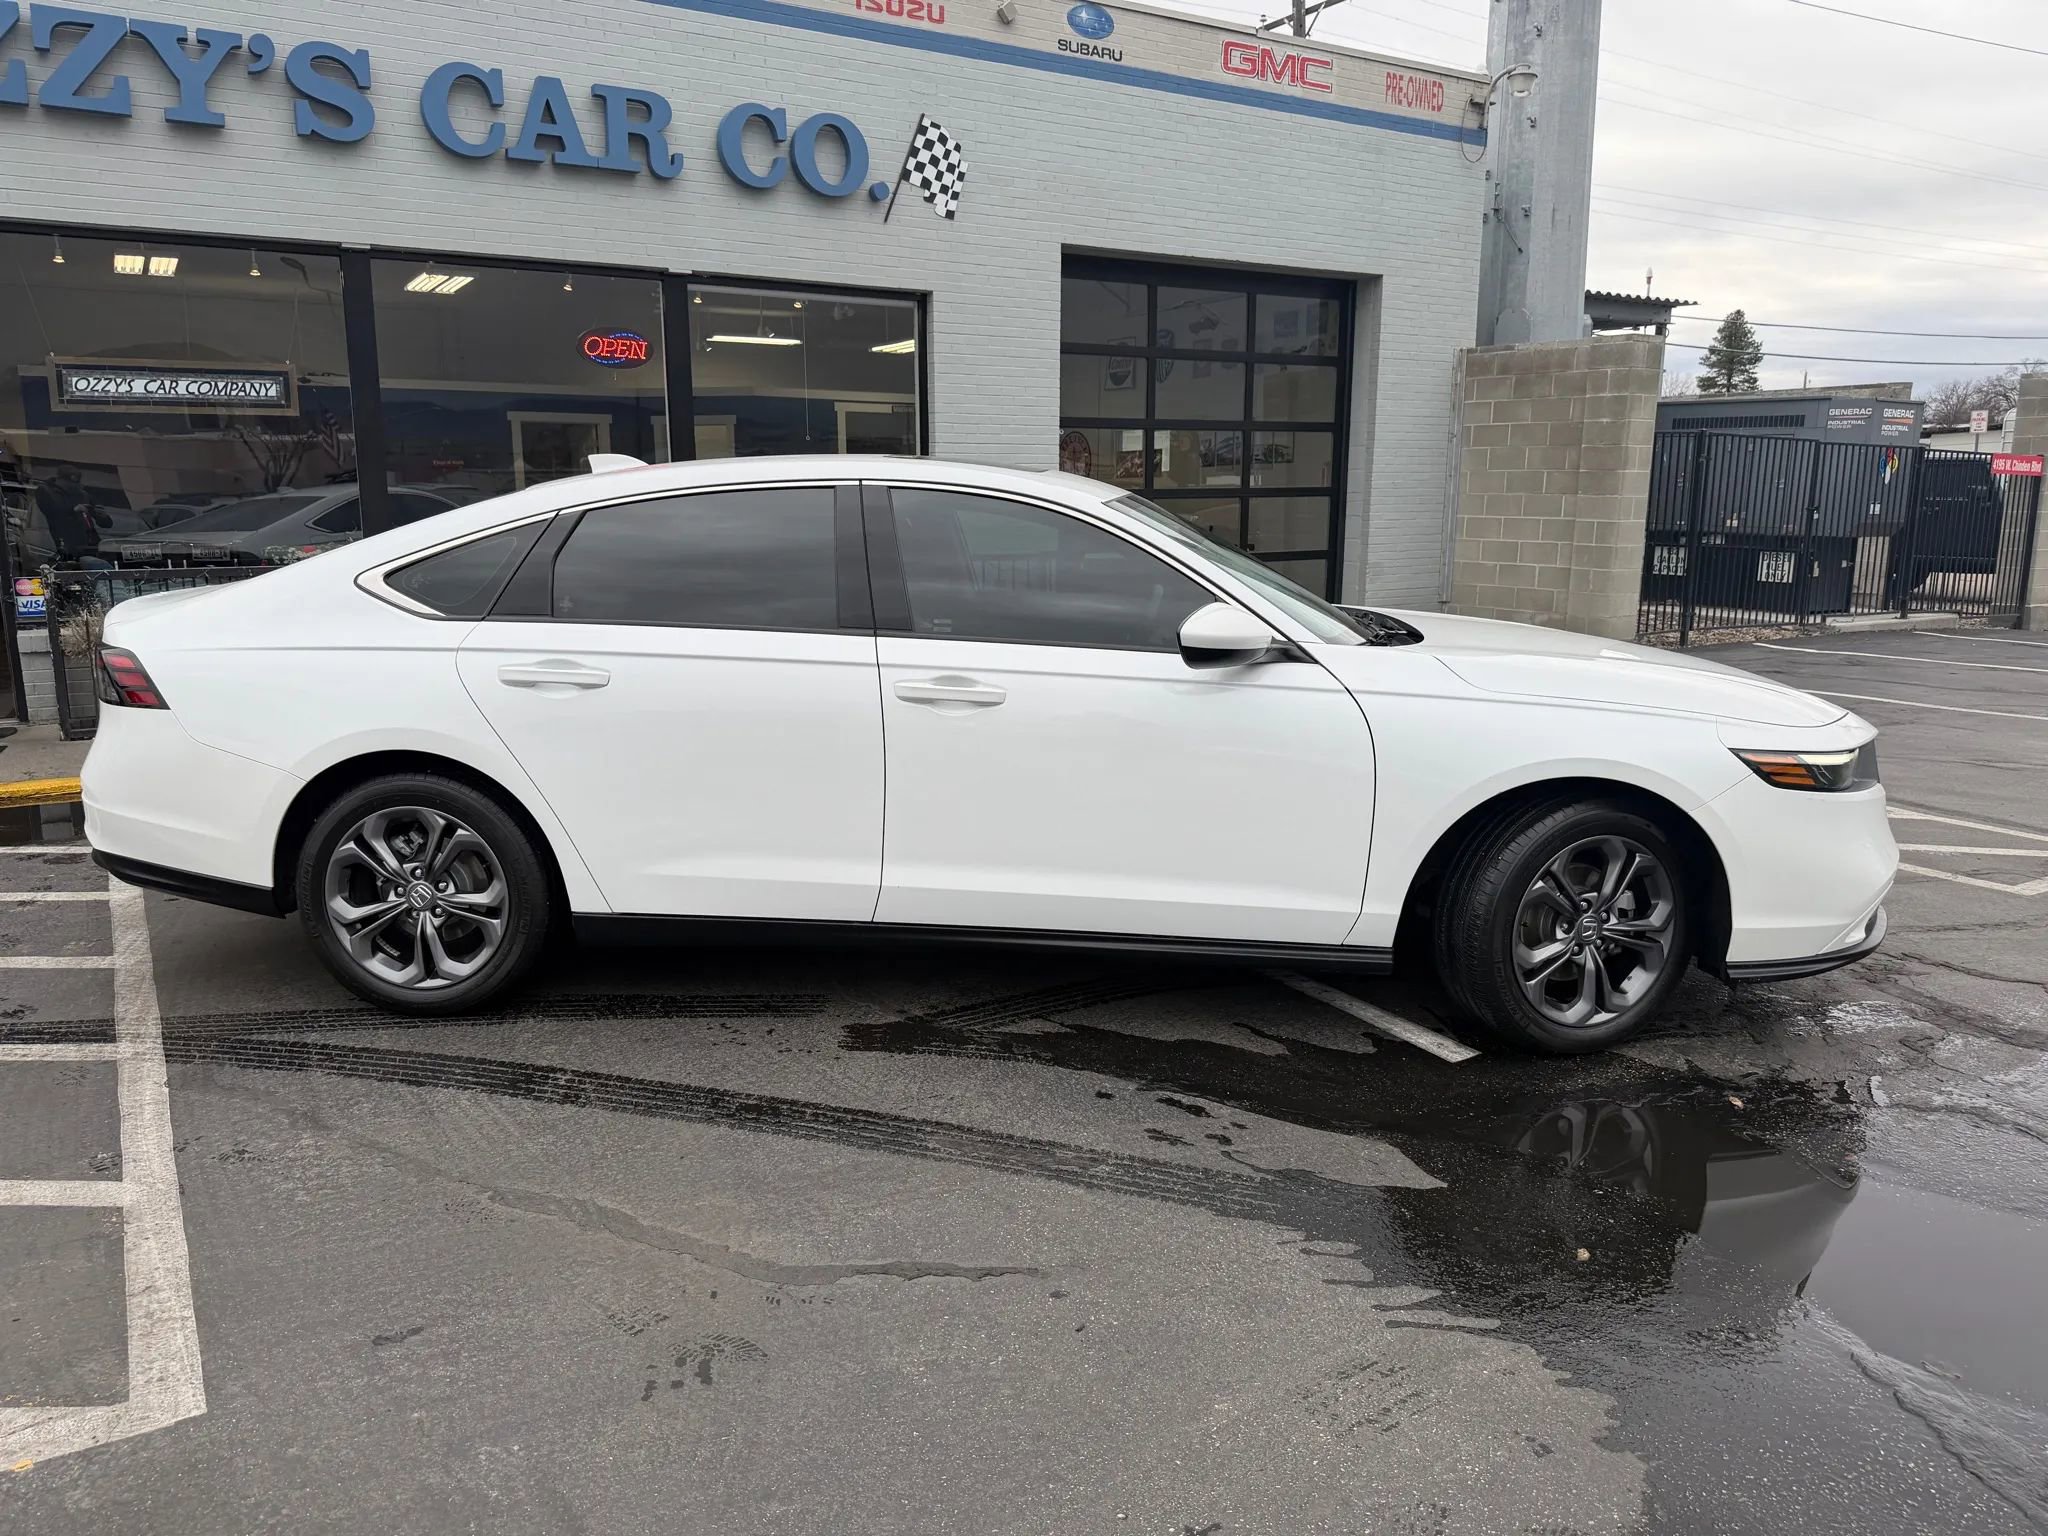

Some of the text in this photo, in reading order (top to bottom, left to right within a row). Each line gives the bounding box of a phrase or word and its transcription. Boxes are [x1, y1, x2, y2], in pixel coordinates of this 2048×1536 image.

[1057, 38, 1123, 62] SUBARU
[1221, 39, 1333, 94] GMC
[0, 1, 890, 201] ZY'S CAR CO.
[1385, 71, 1445, 112] PRE-OWNED
[584, 336, 648, 360] OPEN
[74, 377, 274, 397] OZZY'S CAR COMPANY
[1829, 408, 1873, 416] GENERAC
[1883, 408, 1915, 418] GENERAC
